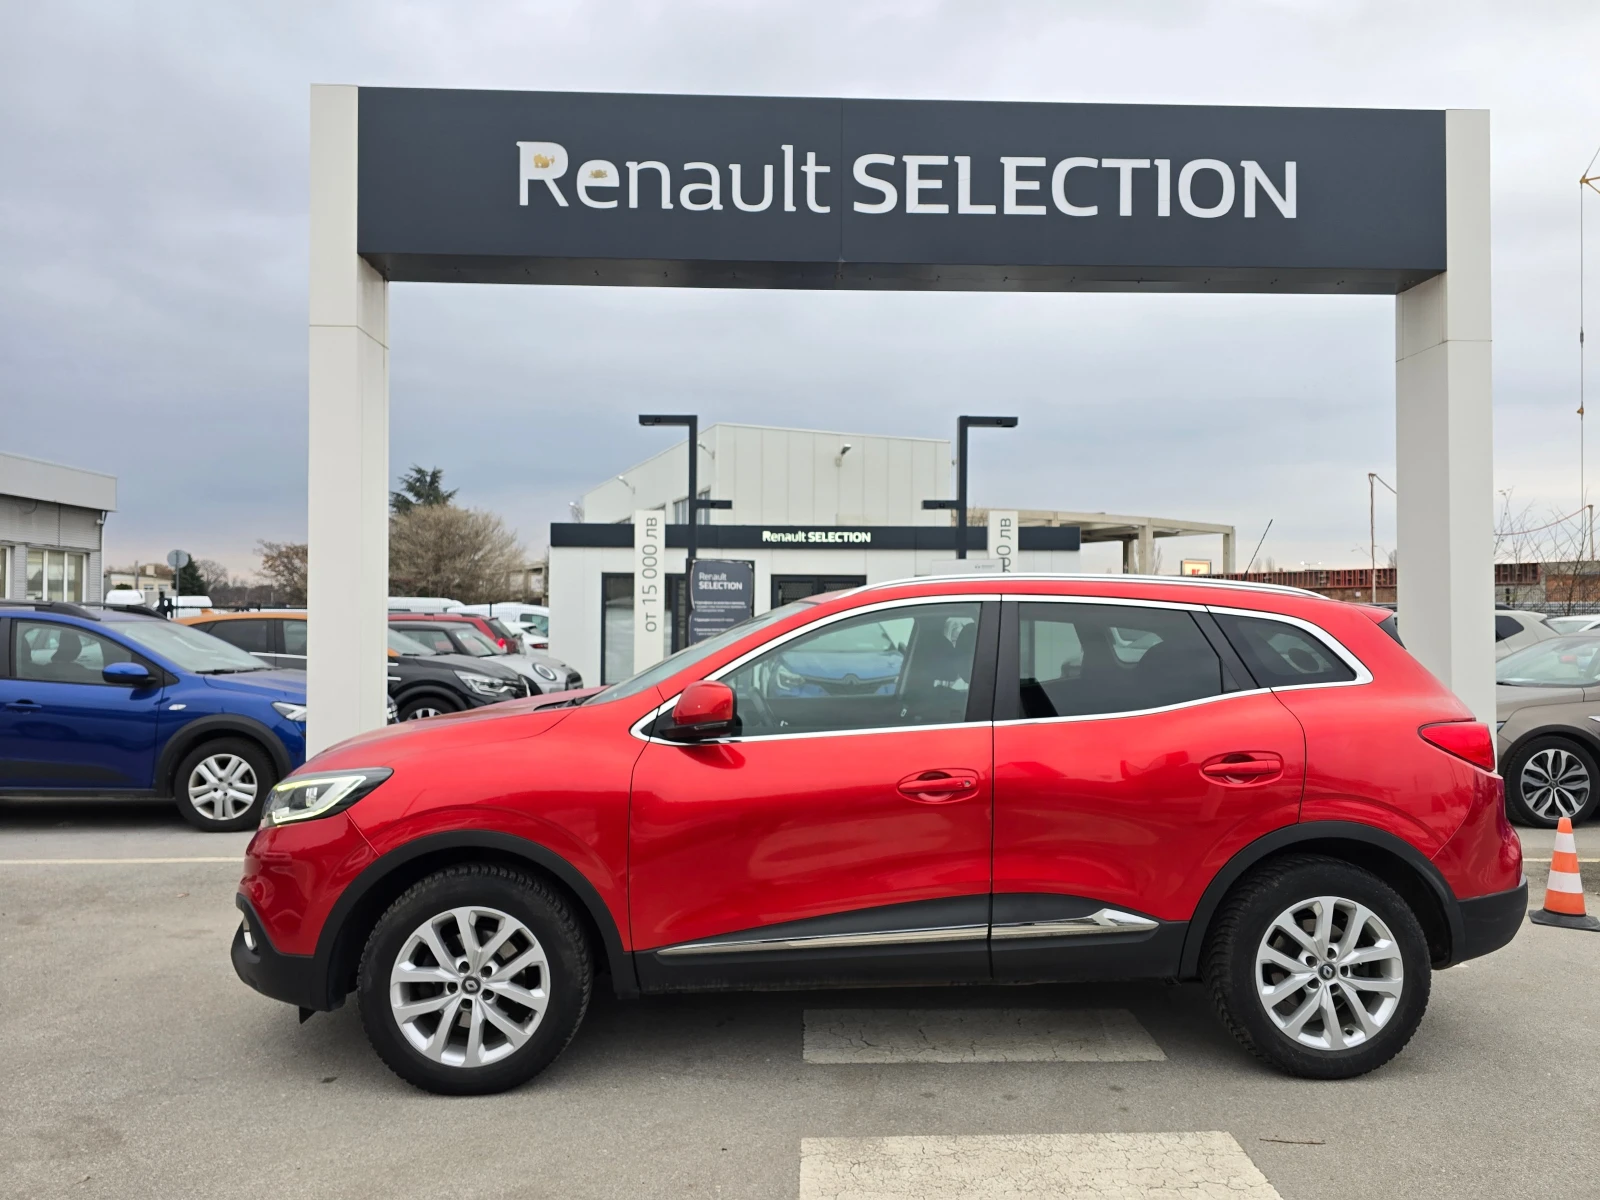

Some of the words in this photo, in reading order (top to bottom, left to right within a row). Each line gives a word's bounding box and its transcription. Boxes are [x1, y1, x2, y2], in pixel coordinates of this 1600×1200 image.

[516, 141, 831, 214] Renault
[852, 153, 1298, 219] SELECTION
[762, 530, 806, 542] Renault
[807, 531, 871, 543] SELECTION
[642, 544, 657, 579] 000
[699, 572, 727, 581] Renault
[699, 581, 743, 591] SELECTION
[642, 585, 657, 605] 15
